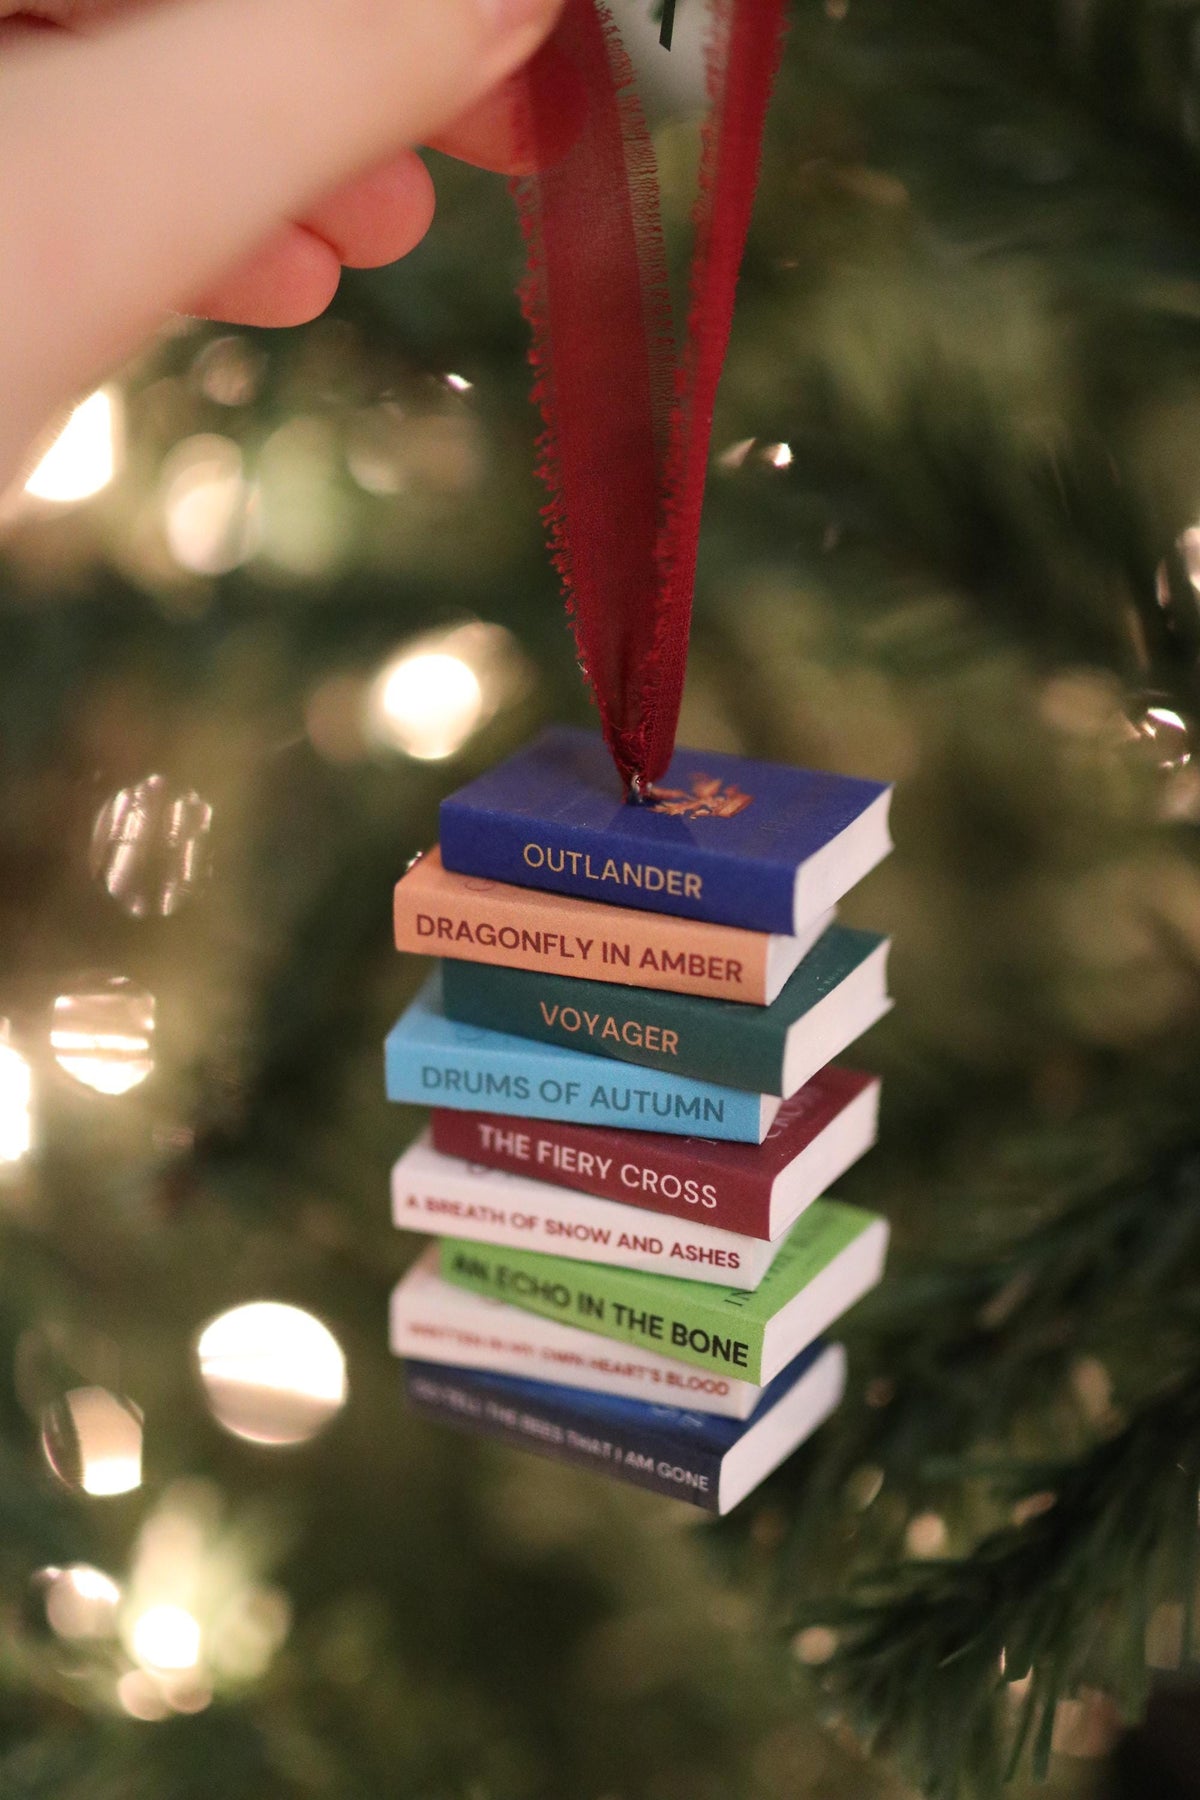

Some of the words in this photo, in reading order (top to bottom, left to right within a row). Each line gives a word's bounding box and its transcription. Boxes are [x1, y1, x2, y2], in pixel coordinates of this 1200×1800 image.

[523, 844, 702, 899] OUTLANDER
[416, 913, 594, 961] DRAGONFLY
[602, 941, 631, 967] IN
[638, 947, 743, 983] AMBER
[540, 1001, 679, 1055] VOYAGER
[421, 1066, 530, 1099] DRUMS
[539, 1079, 581, 1105] OF
[590, 1085, 725, 1123] AUTUMN
[477, 1123, 531, 1160] THE
[537, 1140, 613, 1180] FIERY
[620, 1164, 718, 1208] CROSS
[405, 1194, 420, 1209] A
[424, 1195, 507, 1226] BREATH
[511, 1211, 538, 1232] OF
[545, 1218, 613, 1246] SNOW
[617, 1233, 664, 1256] AND
[670, 1241, 741, 1270] ASHES
[452, 1254, 488, 1281] AN
[496, 1265, 572, 1309] ECHO
[577, 1292, 605, 1320] IN
[612, 1301, 664, 1340] THE
[671, 1322, 749, 1368] BONE
[665, 1371, 730, 1397] BLOOD
[624, 1450, 655, 1474] AM
[655, 1461, 710, 1493] GONE
